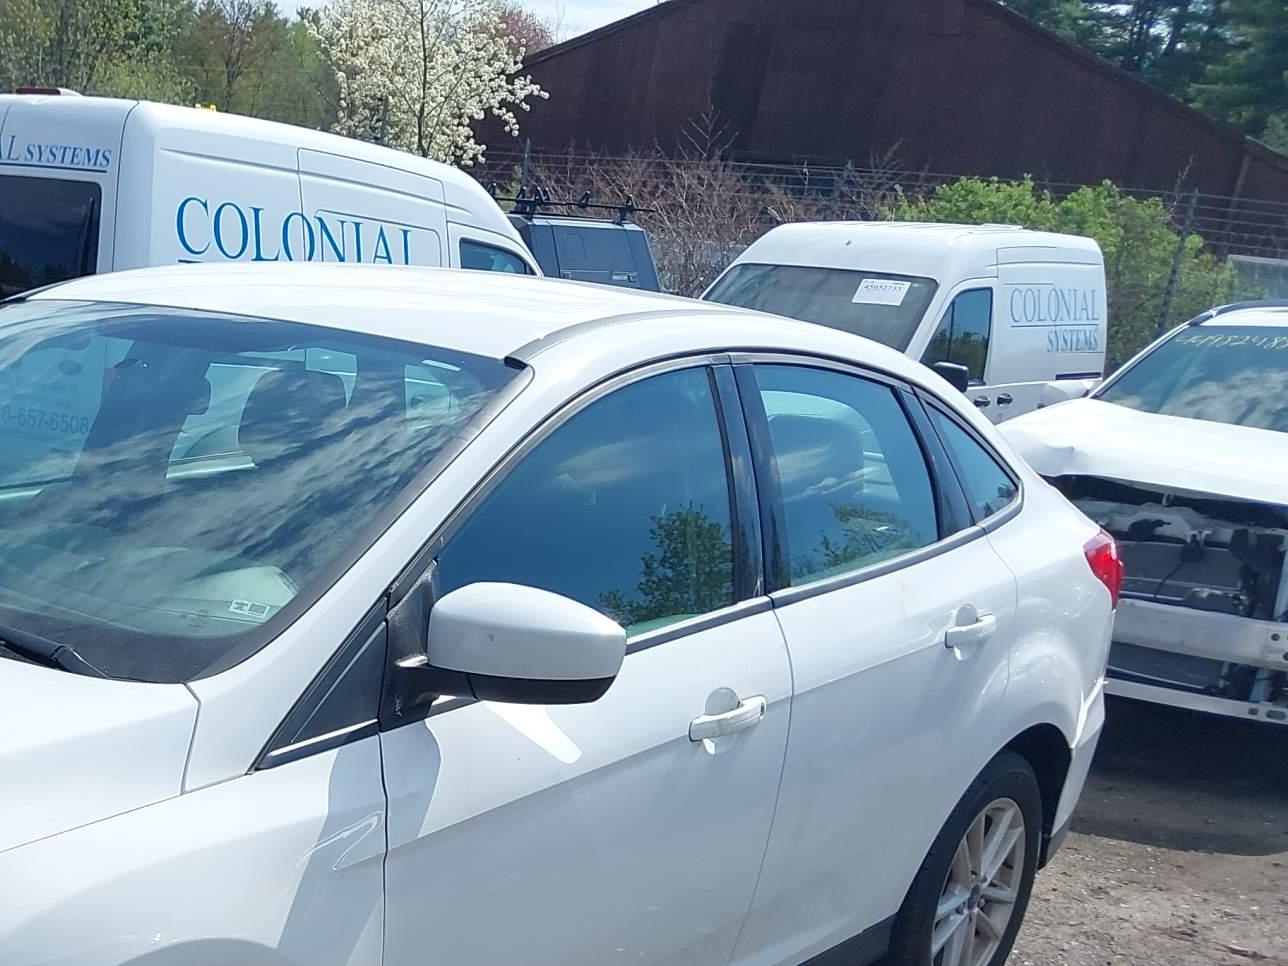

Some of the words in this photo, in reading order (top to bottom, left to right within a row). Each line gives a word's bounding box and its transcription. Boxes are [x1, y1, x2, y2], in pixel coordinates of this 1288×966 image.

[24, 142, 112, 168] SYSTEMS
[176, 196, 413, 266] COLONIAL
[1010, 288, 1100, 323] COLONIAL
[1047, 329, 1098, 353] SYSTEMS
